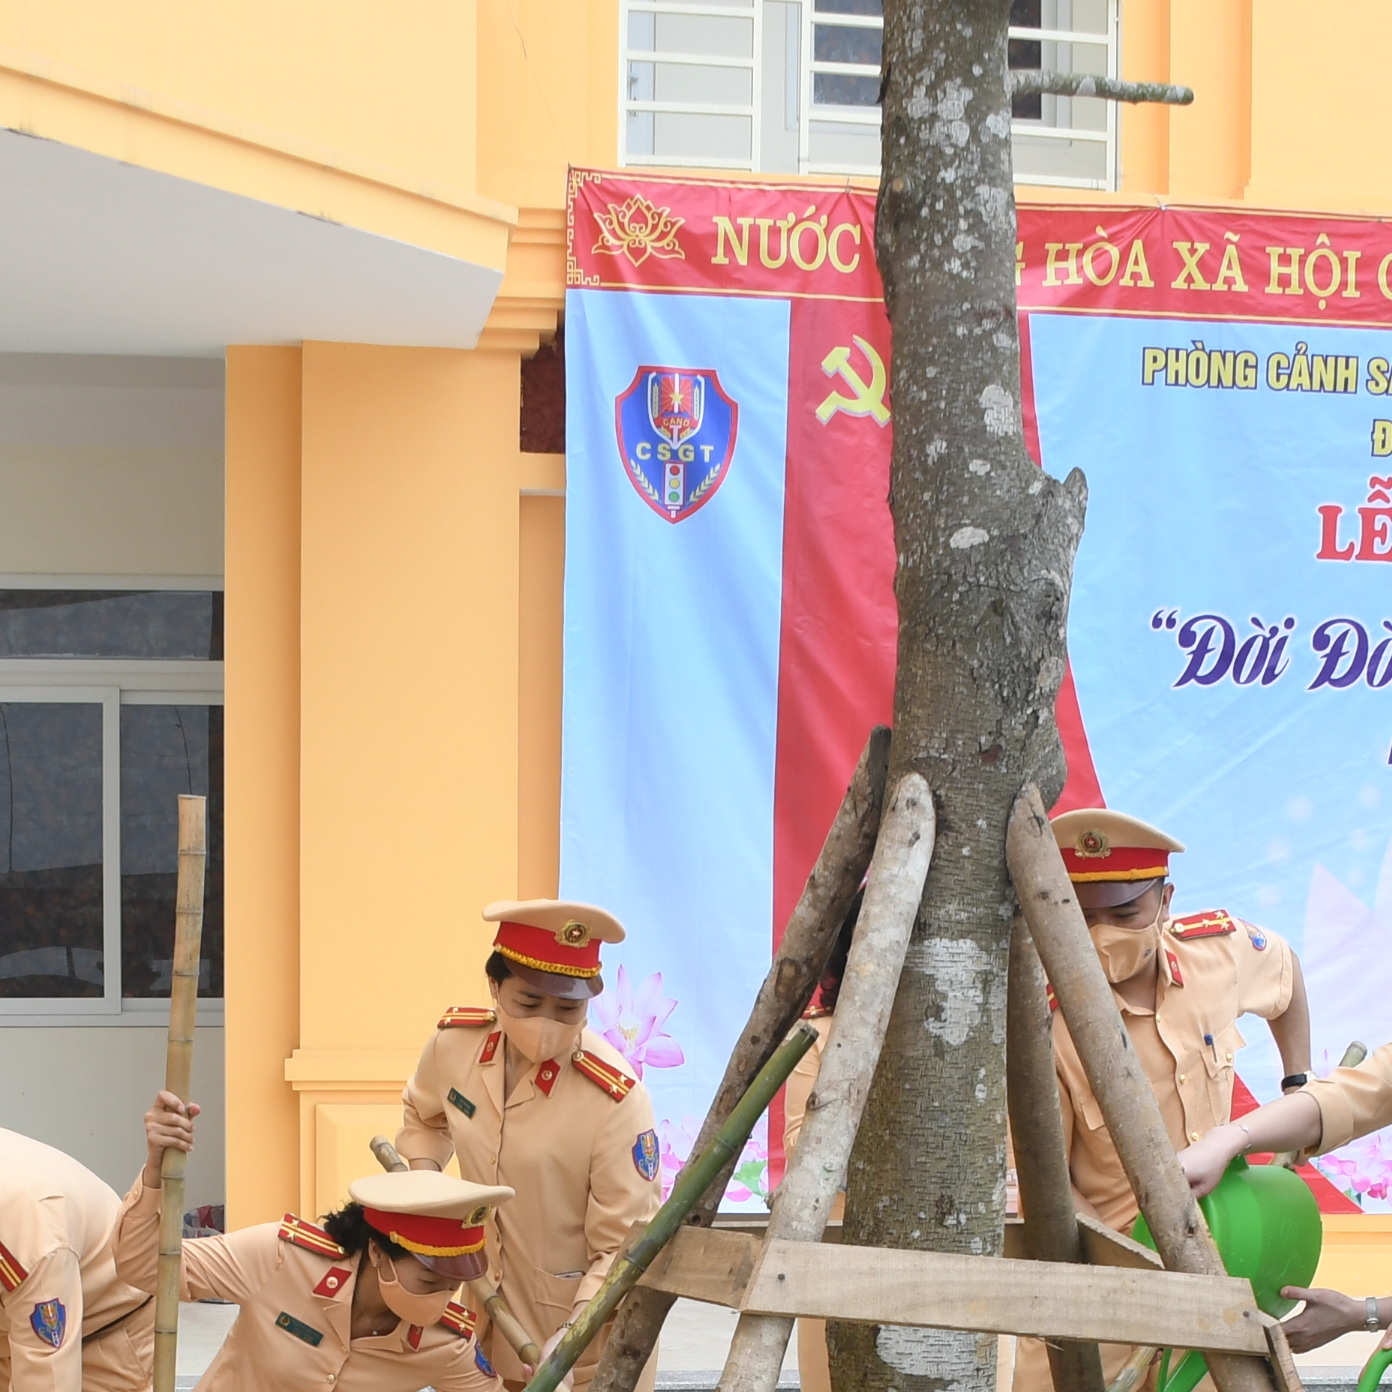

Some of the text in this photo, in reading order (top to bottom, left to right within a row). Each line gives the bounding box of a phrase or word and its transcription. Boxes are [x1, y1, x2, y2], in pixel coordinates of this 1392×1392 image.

[711, 204, 861, 273] NƯỚC
[1041, 225, 1155, 287] HÒA
[1171, 231, 1249, 292] XÃ
[1264, 233, 1361, 310] HỘI
[1142, 340, 1258, 390] PHÒNG
[1266, 341, 1359, 394] CẢNH
[636, 442, 714, 463] CSGT
